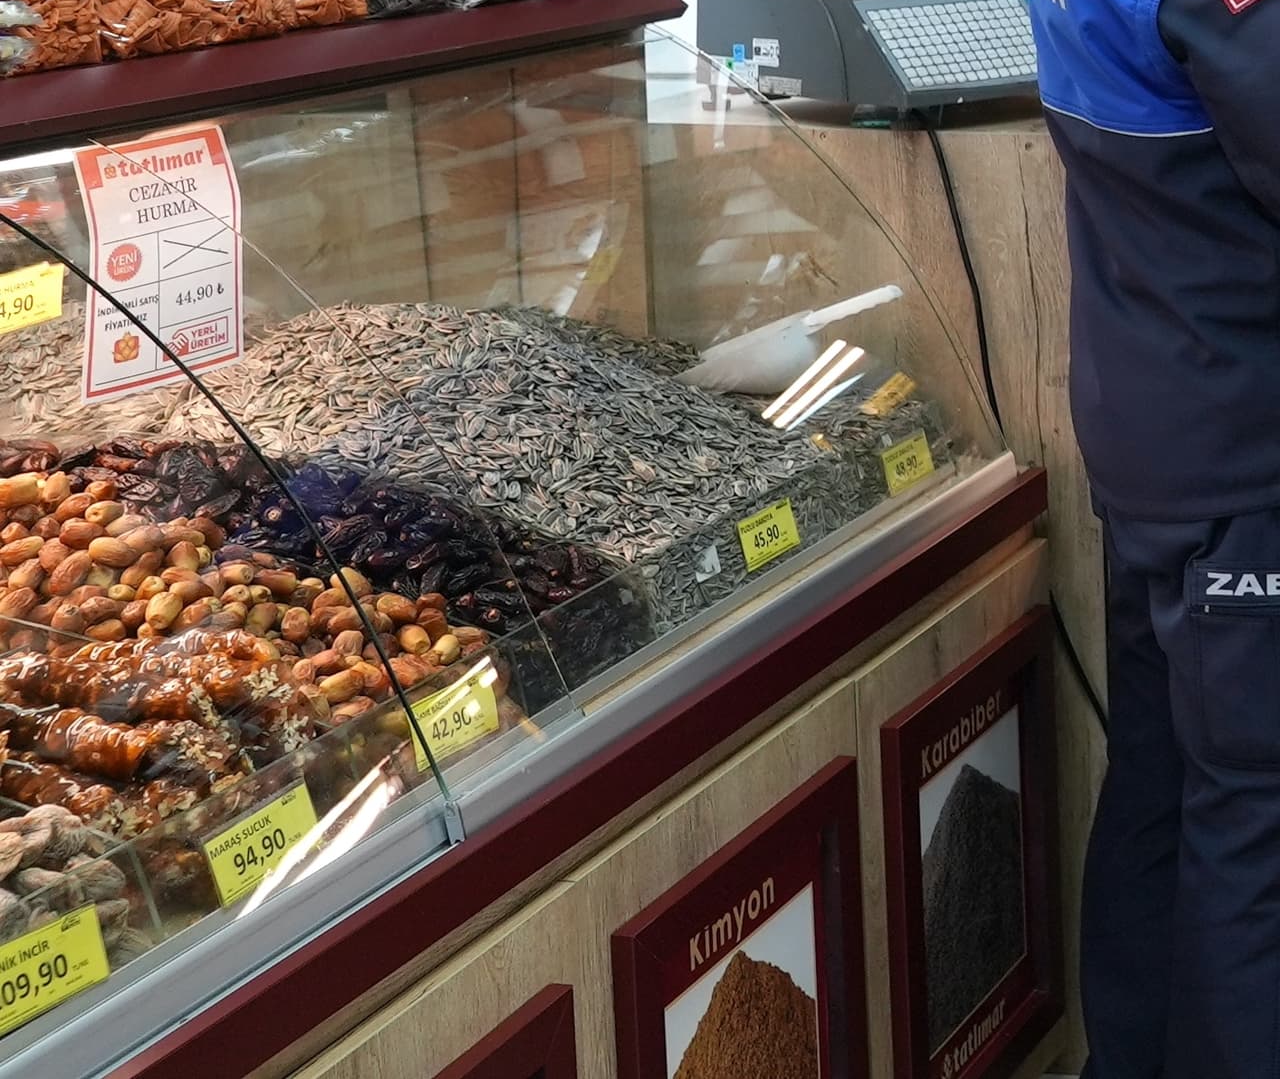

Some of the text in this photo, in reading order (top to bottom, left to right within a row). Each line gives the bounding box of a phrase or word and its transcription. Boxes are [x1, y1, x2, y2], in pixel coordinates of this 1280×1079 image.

[116, 148, 204, 178] tatlımar
[129, 177, 197, 204] CEZAYİR
[137, 200, 199, 224] HURMA
[111, 249, 138, 267] YENİ
[0, 293, 34, 320] 4,90
[139, 293, 160, 308] SATIŞ
[176, 284, 214, 307] 44,90
[190, 331, 226, 350] ÜRETİM
[191, 325, 219, 339] YERLİ
[754, 524, 780, 549] 45,90
[920, 687, 1002, 777] Karabiber
[209, 814, 272, 860] MARAŞ SUCUK
[233, 828, 286, 876] 94,90
[688, 873, 776, 972] Kimyon
[0, 940, 50, 972] NİK İNCİR
[0, 953, 69, 1010] 09,90
